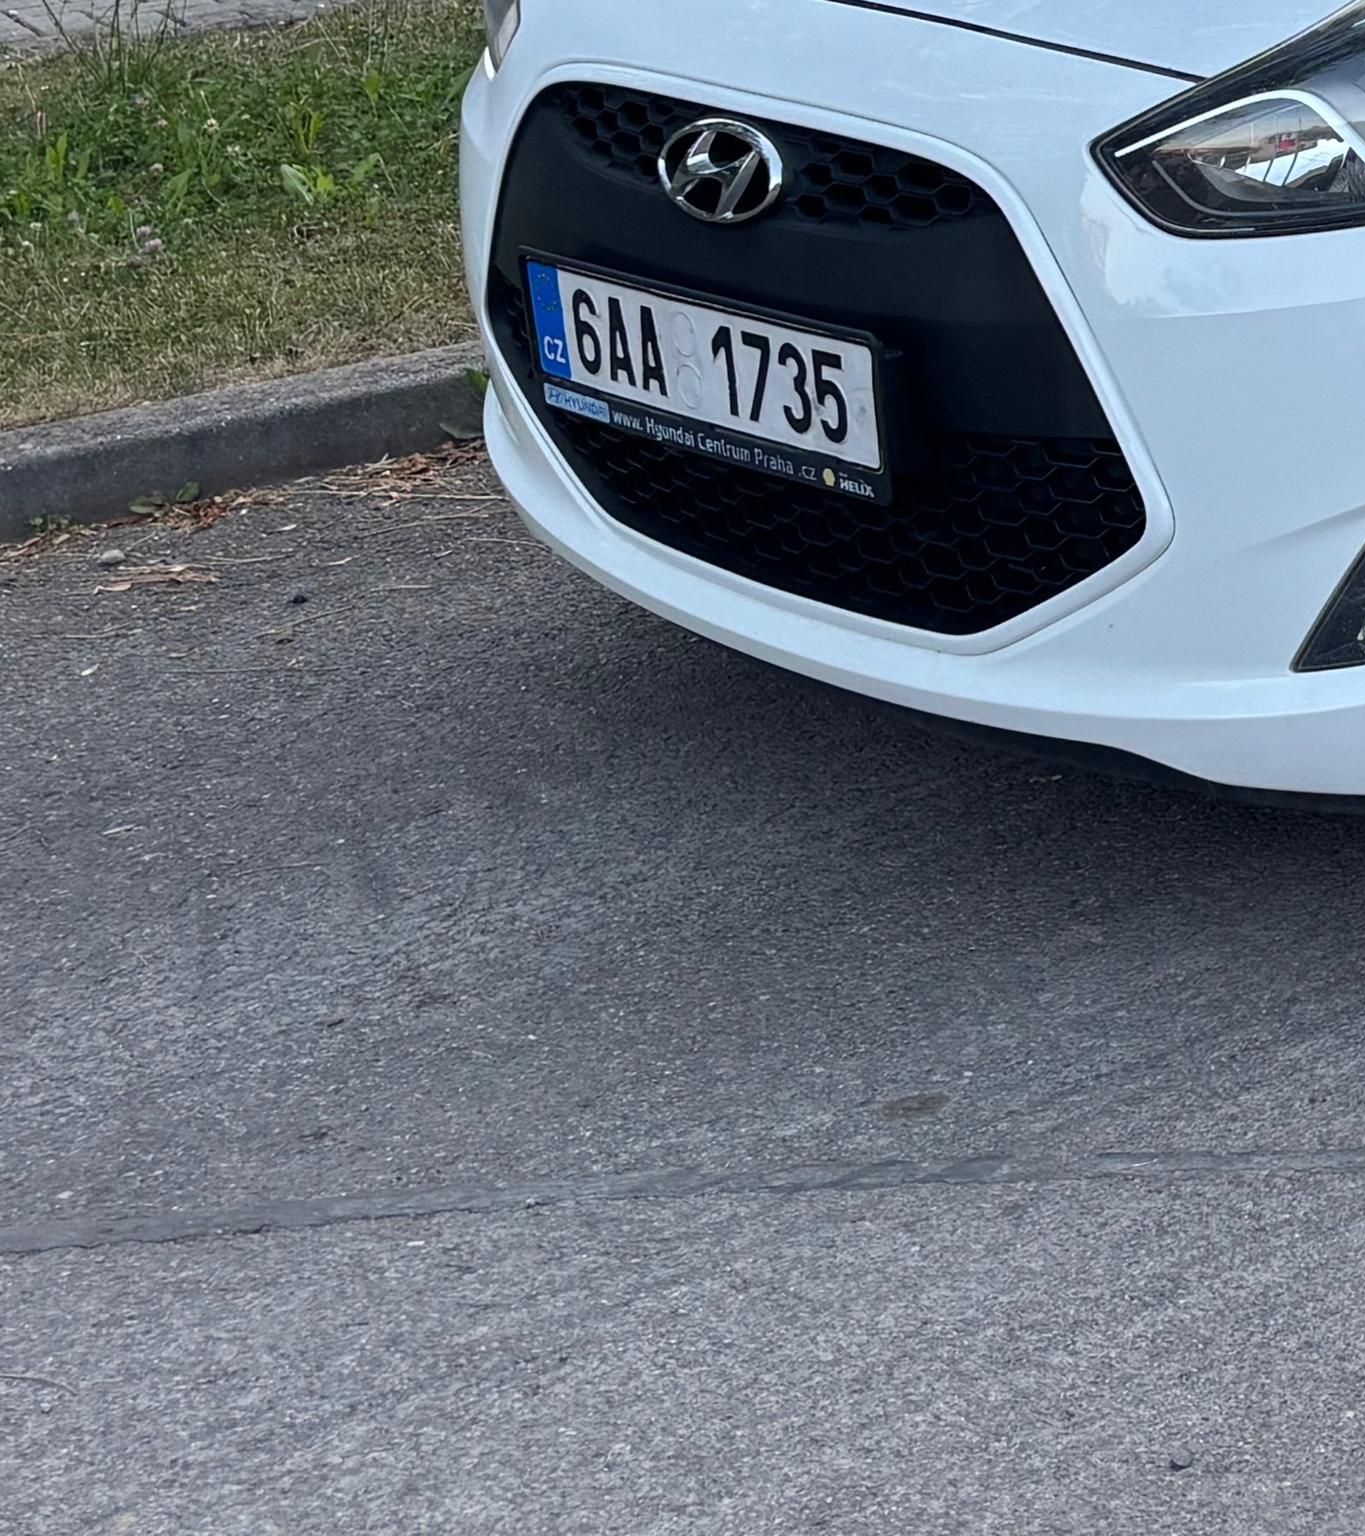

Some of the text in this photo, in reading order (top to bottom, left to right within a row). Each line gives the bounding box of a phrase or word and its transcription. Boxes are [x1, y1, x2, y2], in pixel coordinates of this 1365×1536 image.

[543, 336, 566, 363] CZ
[571, 288, 848, 444] 6AA 1735
[645, 415, 696, 448] Hyundai
[698, 430, 750, 462] Centrum
[754, 448, 794, 475] Praha
